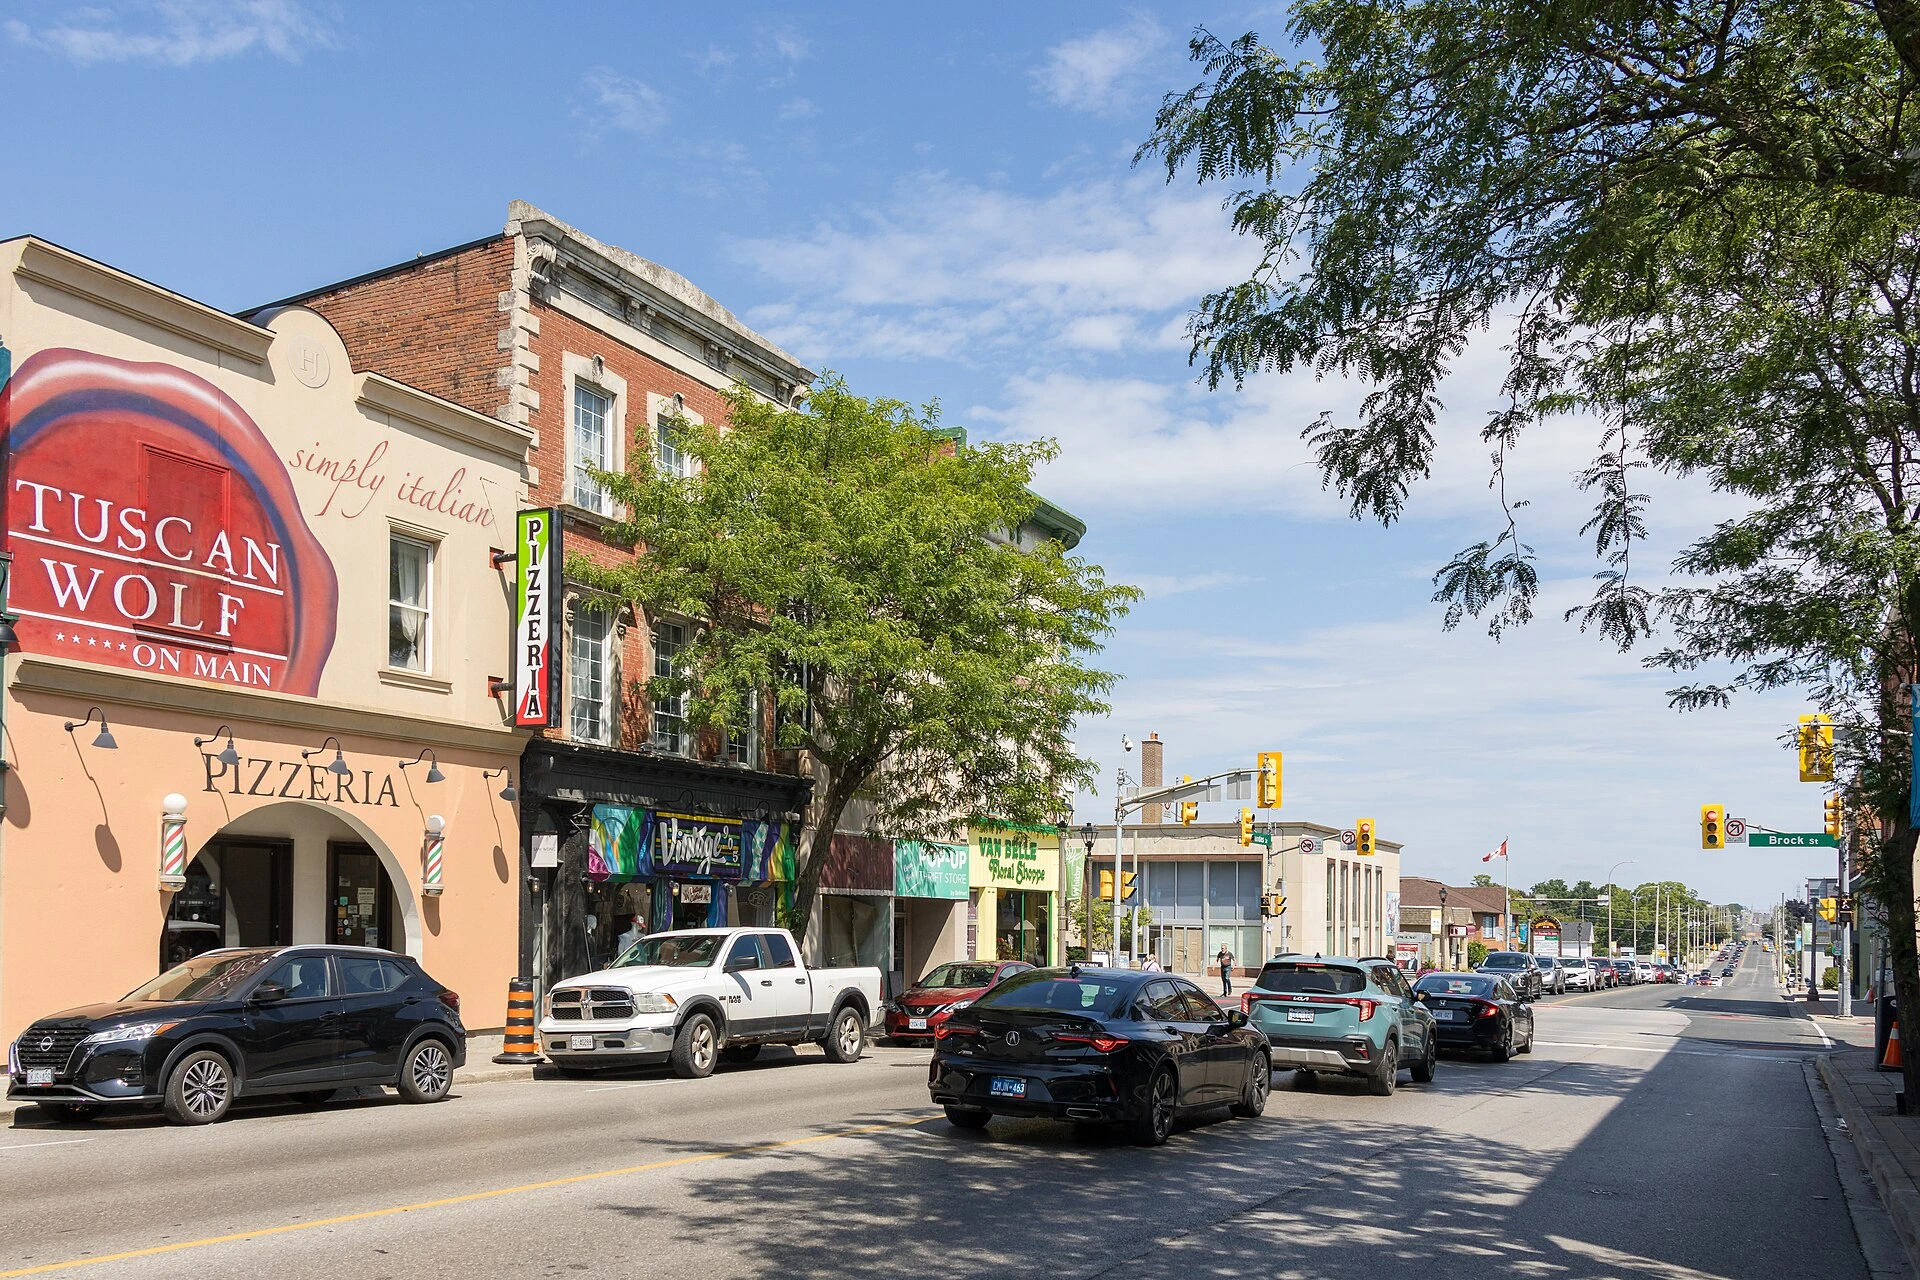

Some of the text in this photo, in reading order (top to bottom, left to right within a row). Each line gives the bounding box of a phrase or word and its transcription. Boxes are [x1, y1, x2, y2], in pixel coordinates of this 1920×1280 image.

[288, 440, 496, 527] simply italian
[15, 479, 281, 585] TUSCAN
[40, 557, 245, 637] WOLF
[526, 518, 543, 717] PIZZERIA
[132, 643, 272, 687] ON MAIN
[202, 752, 401, 808] PIZZERIA
[659, 817, 727, 875] Vintage
[918, 845, 967, 870] POP-UP
[978, 837, 1038, 861] VAN BELLE
[1768, 835, 1805, 845] Brock
[944, 872, 967, 885] STORE
[988, 858, 1046, 885] Floral Shoppe
[1071, 865, 1082, 897] Whitby
[1013, 1083, 1025, 1093] 463
